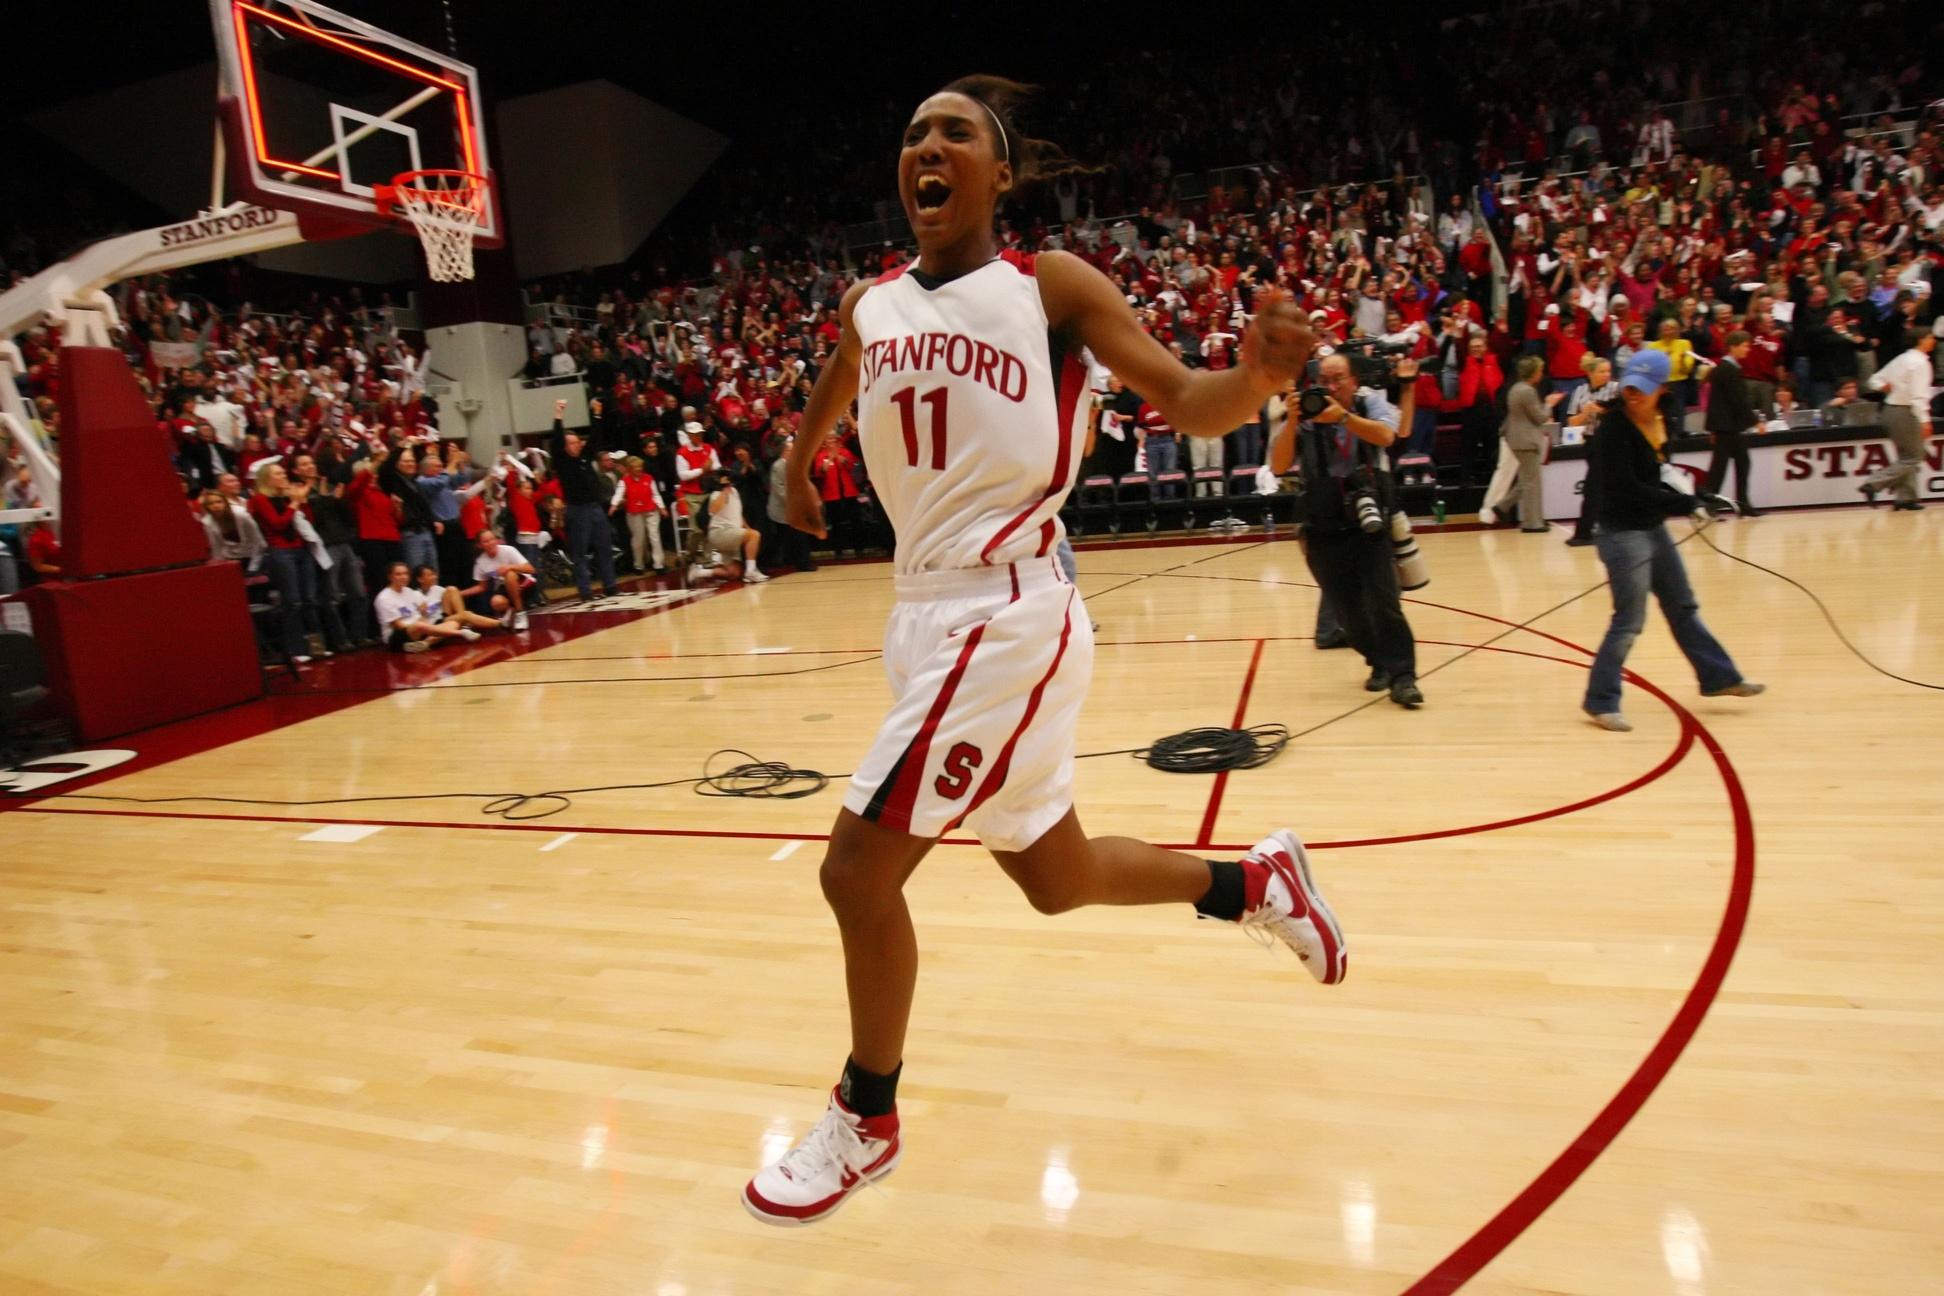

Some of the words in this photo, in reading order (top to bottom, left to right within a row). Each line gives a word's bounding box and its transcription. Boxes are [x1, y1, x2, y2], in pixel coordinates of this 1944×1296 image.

[159, 207, 278, 246] STANFORD
[864, 333, 1027, 403] STANFORD
[890, 386, 948, 470] 11
[934, 741, 983, 800] S
